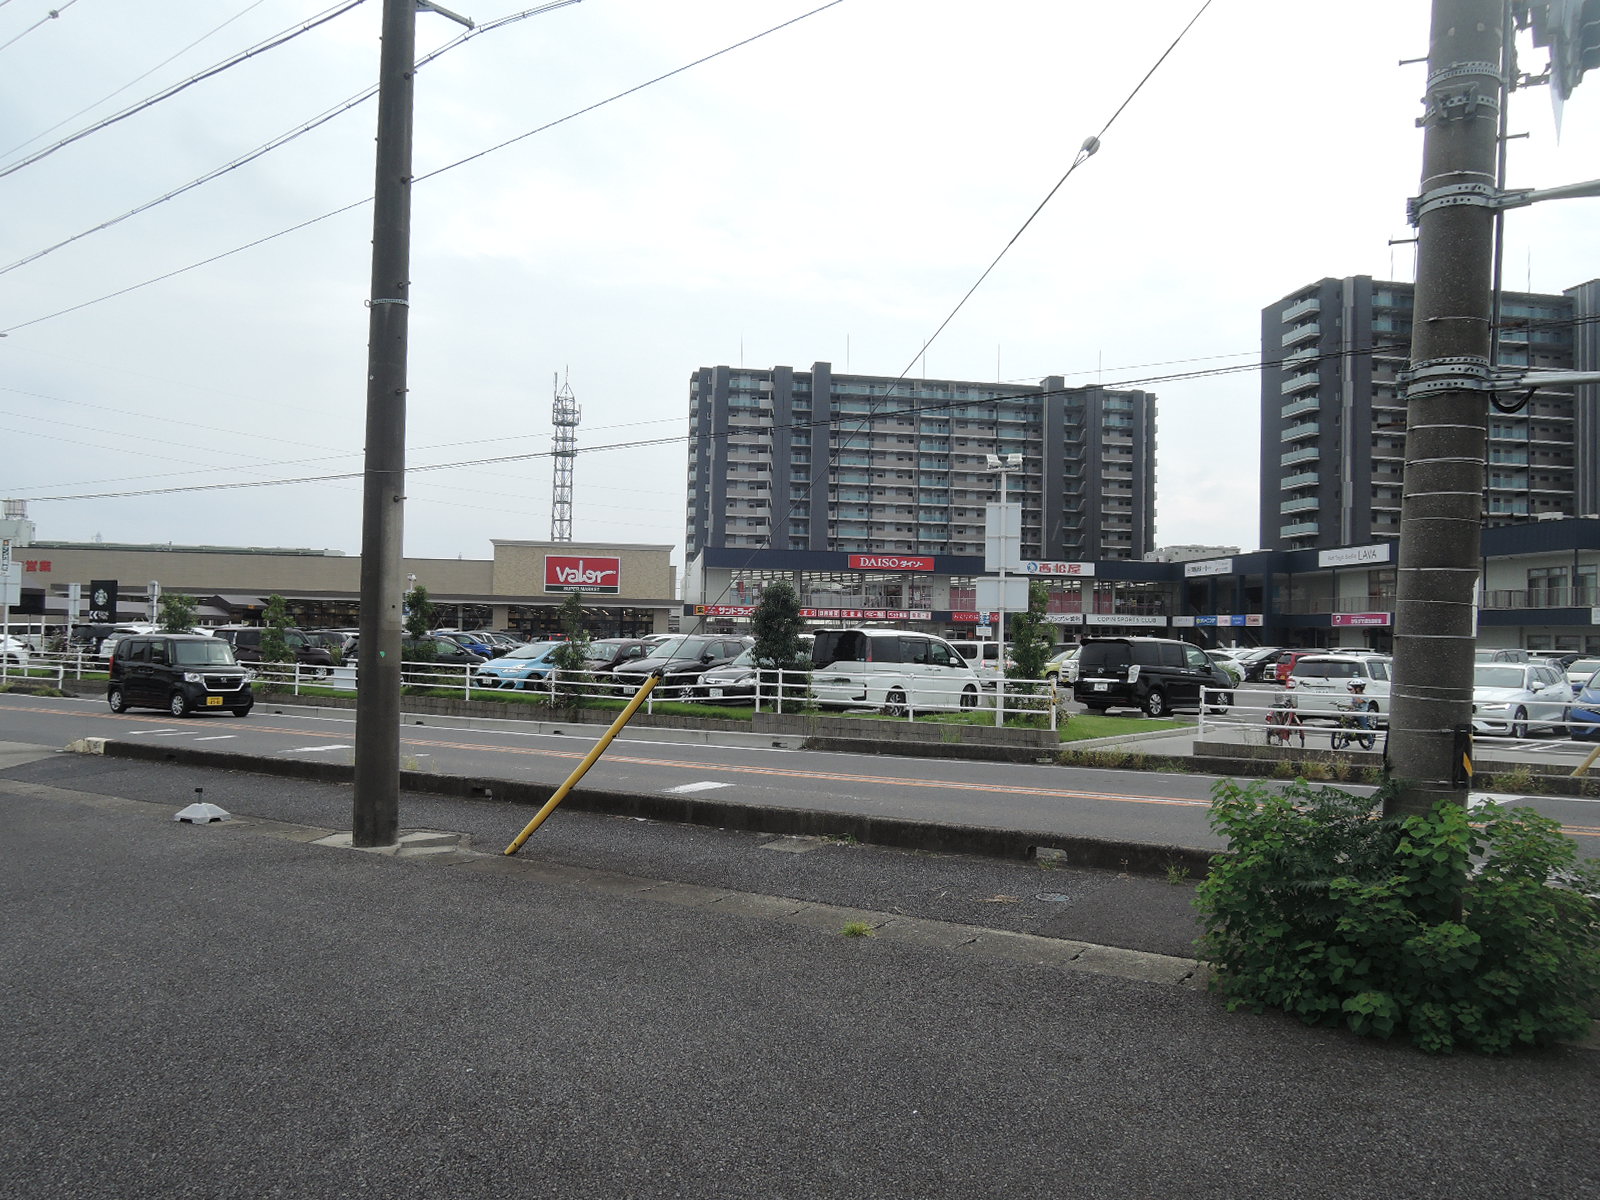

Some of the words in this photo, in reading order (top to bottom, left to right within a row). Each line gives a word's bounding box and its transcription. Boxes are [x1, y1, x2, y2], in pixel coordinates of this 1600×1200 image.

[1357, 548, 1377, 561] LAVA
[22, 560, 52, 572] 営業
[859, 557, 899, 567] DAISO
[899, 560, 924, 568] ダイソー
[1039, 562, 1081, 574] 西松屋
[718, 606, 756, 616] サンドラッグ
